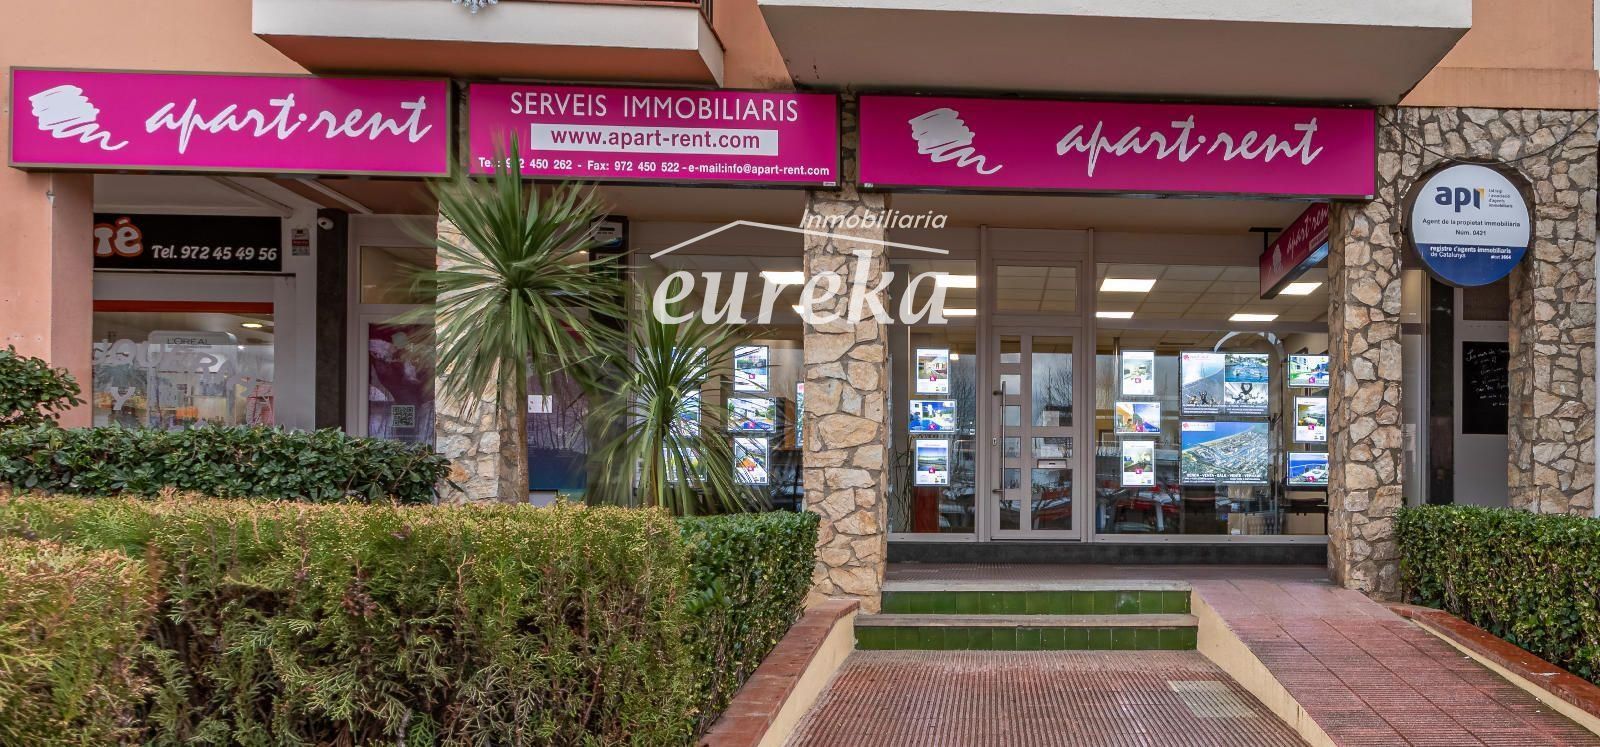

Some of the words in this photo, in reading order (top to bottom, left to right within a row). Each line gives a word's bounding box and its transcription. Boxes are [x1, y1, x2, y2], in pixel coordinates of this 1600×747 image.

[510, 92, 607, 117] SERVEIS
[624, 95, 799, 122] IMMOBILIARIS
[551, 128, 761, 150] www.apart-rent.com
[505, 157, 525, 169] 92
[529, 158, 549, 169] 450
[553, 159, 573, 170] 262
[587, 160, 609, 171] Fax:
[614, 161, 633, 171] 972
[637, 161, 657, 172] 450
[661, 162, 680, 173] 522
[1456, 219, 1483, 227] propietat
[152, 245, 178, 259] Tel.
[181, 246, 209, 260] 972
[212, 246, 232, 260] 45
[235, 247, 254, 260] 49
[258, 247, 277, 261] 56
[1477, 246, 1512, 254] immobiliaris
